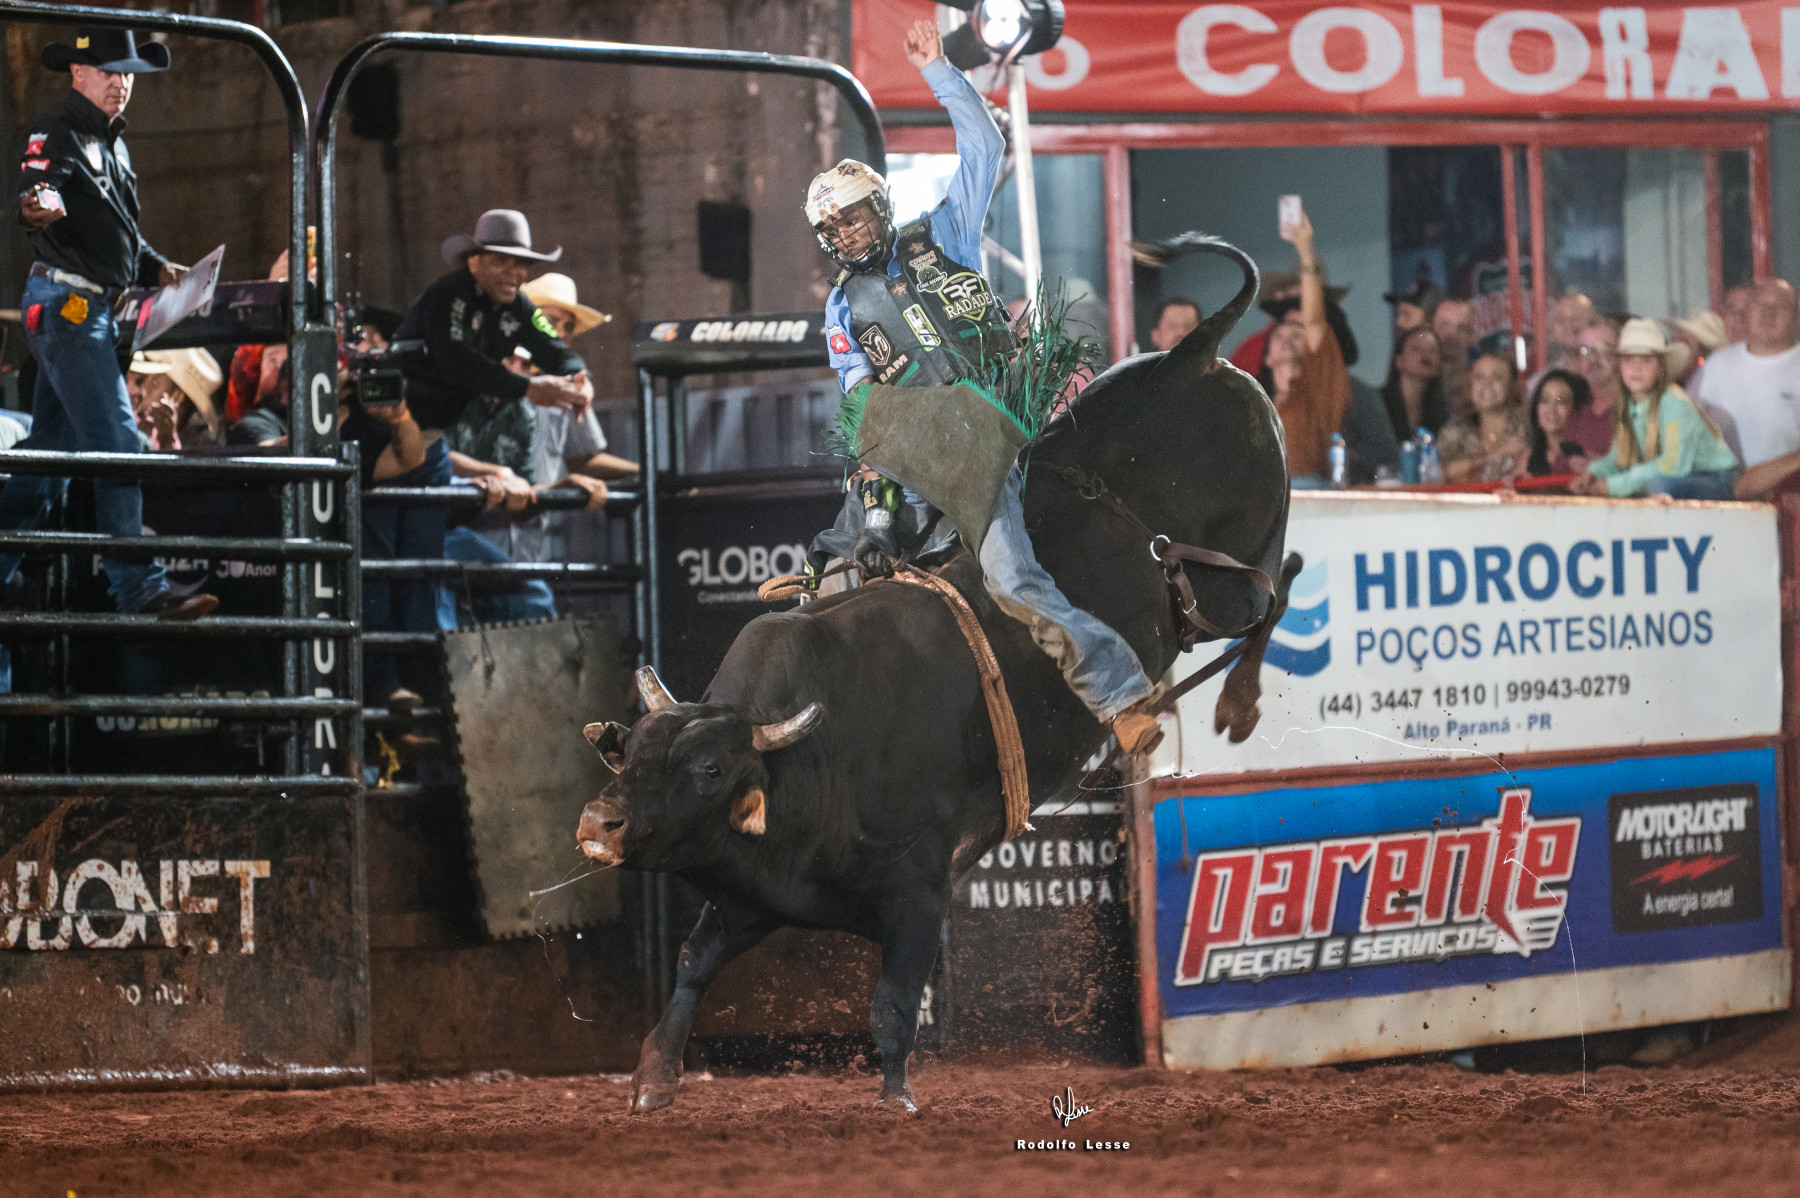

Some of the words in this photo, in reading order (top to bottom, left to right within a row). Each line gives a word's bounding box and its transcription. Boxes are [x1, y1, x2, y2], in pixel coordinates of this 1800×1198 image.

[944, 291, 993, 318] RADADE
[690, 321, 809, 343] COLORADO
[879, 354, 908, 383] RAM
[1354, 536, 1713, 612] HIDROCITY
[1356, 622, 1483, 671] POÇOS
[1493, 609, 1714, 656] ARTESIANOS
[1319, 692, 1362, 721] (44)
[1371, 688, 1422, 712] 3447
[1433, 683, 1486, 707] 1810
[1507, 674, 1630, 701] 99943-0279
[1403, 722, 1440, 740] Alto
[1446, 716, 1510, 737] Paraná
[1527, 713, 1552, 731] PR
[1615, 797, 1748, 842] MOTORLIGHT
[978, 840, 1117, 869] GOVERNO
[1641, 834, 1724, 859] BATERIAS
[1211, 945, 1316, 981] PEÇAS
[1320, 938, 1346, 967] E
[1349, 925, 1500, 962] SERVIÇOS
